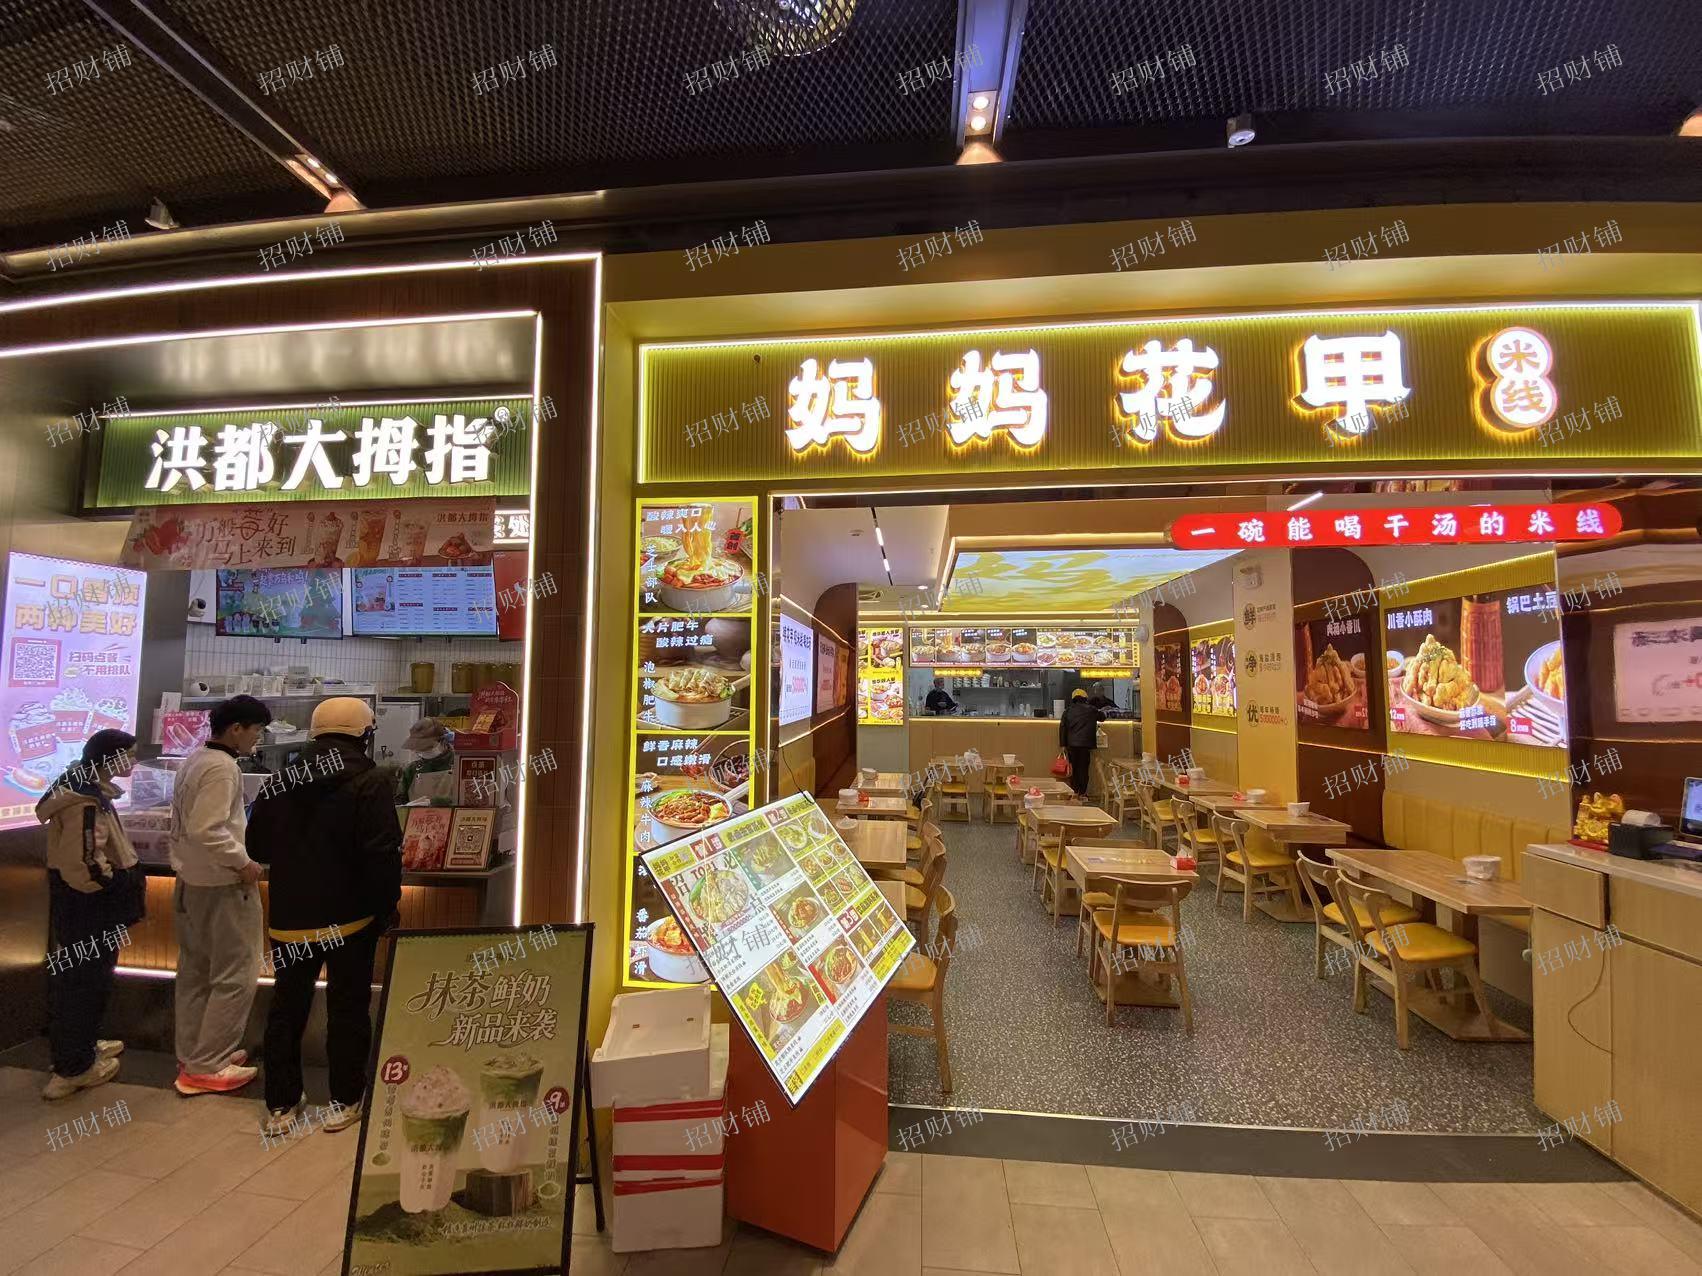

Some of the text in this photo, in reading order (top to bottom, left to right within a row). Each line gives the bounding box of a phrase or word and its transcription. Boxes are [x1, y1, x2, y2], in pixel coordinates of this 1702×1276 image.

[1499, 339, 1547, 413] 米线
[785, 330, 1411, 452] 妈妈花甲
[144, 414, 495, 492] 洪都大拇指
[1190, 508, 1605, 543] 一碗能喝干汤的米线
[1506, 592, 1559, 615] 锅巴土豆
[14, 604, 138, 637] 两种美好
[641, 620, 699, 634] 大片肥牛
[1387, 608, 1434, 630] 川香小酥肉
[655, 635, 714, 648] 酸辣过瘾
[68, 651, 119, 664] 扫码点餐
[82, 663, 131, 676] 不用排队
[1246, 705, 1259, 724] 优
[642, 738, 699, 753] 鲜香麻辣
[656, 753, 712, 767] 口感嫩滑
[640, 780, 655, 843] 麻辣牛肉
[406, 969, 552, 1021] 抹茶鲜奶
[436, 1008, 558, 1051] 新品来袭
